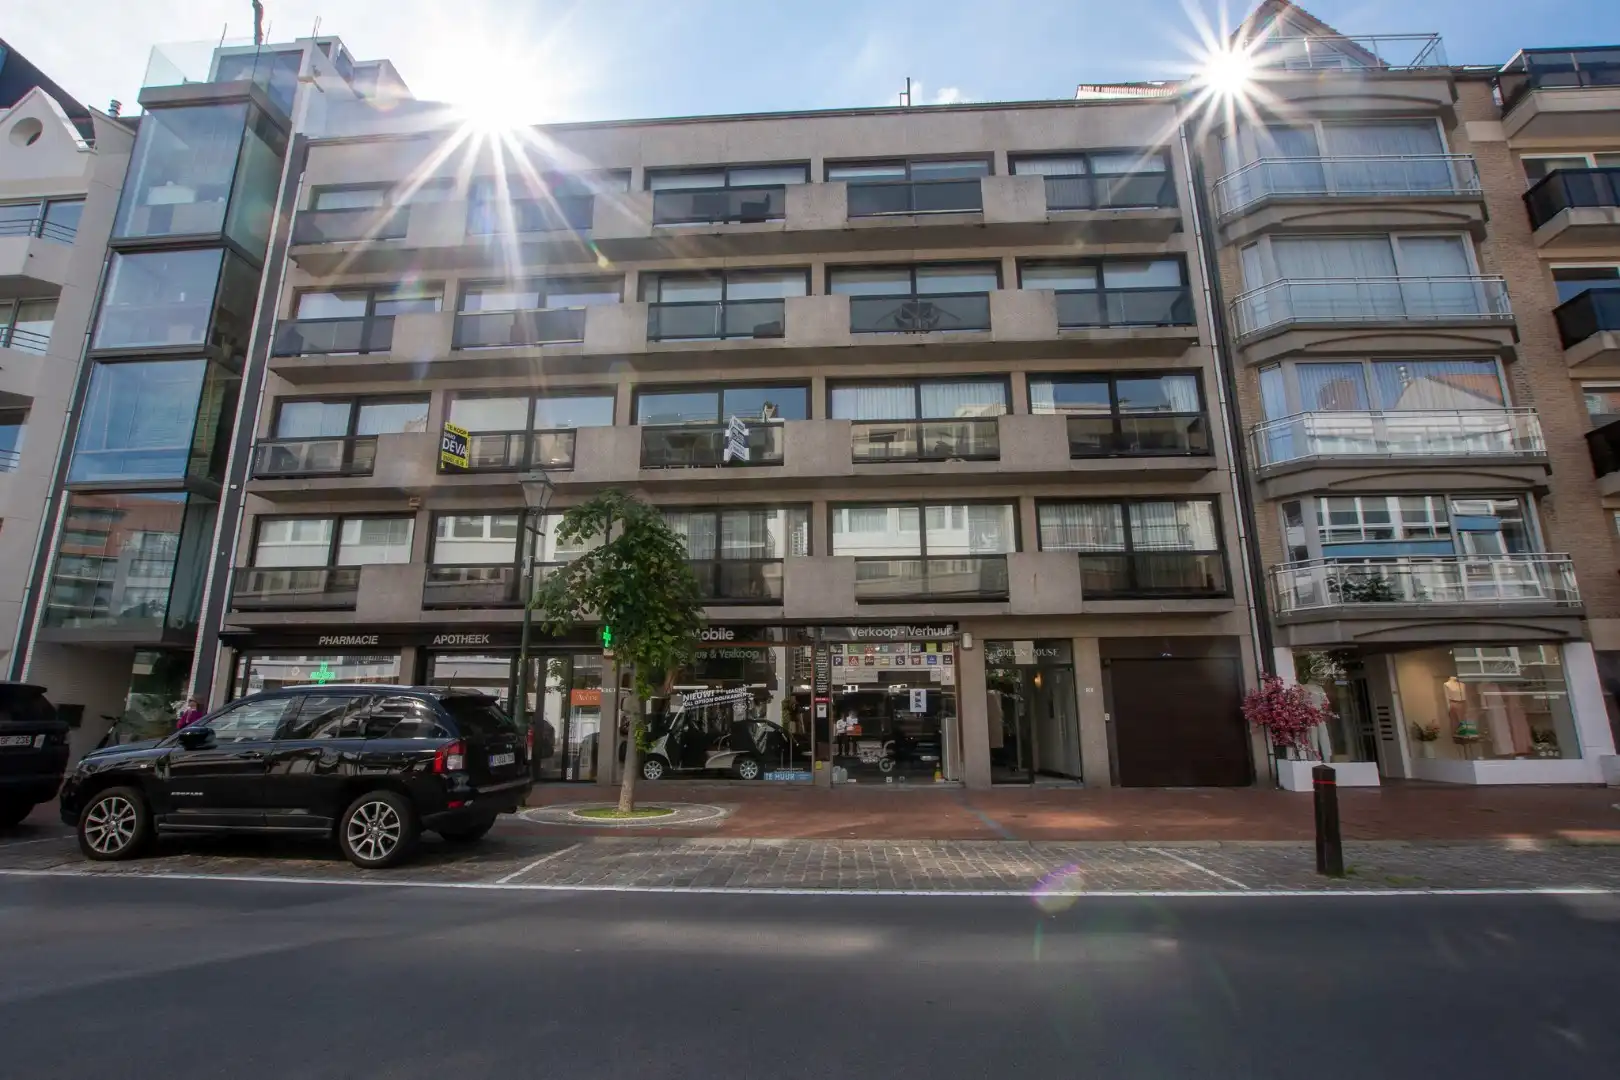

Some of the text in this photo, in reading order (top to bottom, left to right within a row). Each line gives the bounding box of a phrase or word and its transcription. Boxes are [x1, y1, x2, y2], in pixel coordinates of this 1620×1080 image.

[849, 626, 898, 639] Verkoop
[906, 625, 952, 637] Verhuur
[318, 635, 379, 646] PHARMACIE
[433, 634, 490, 645] APOTHEEK
